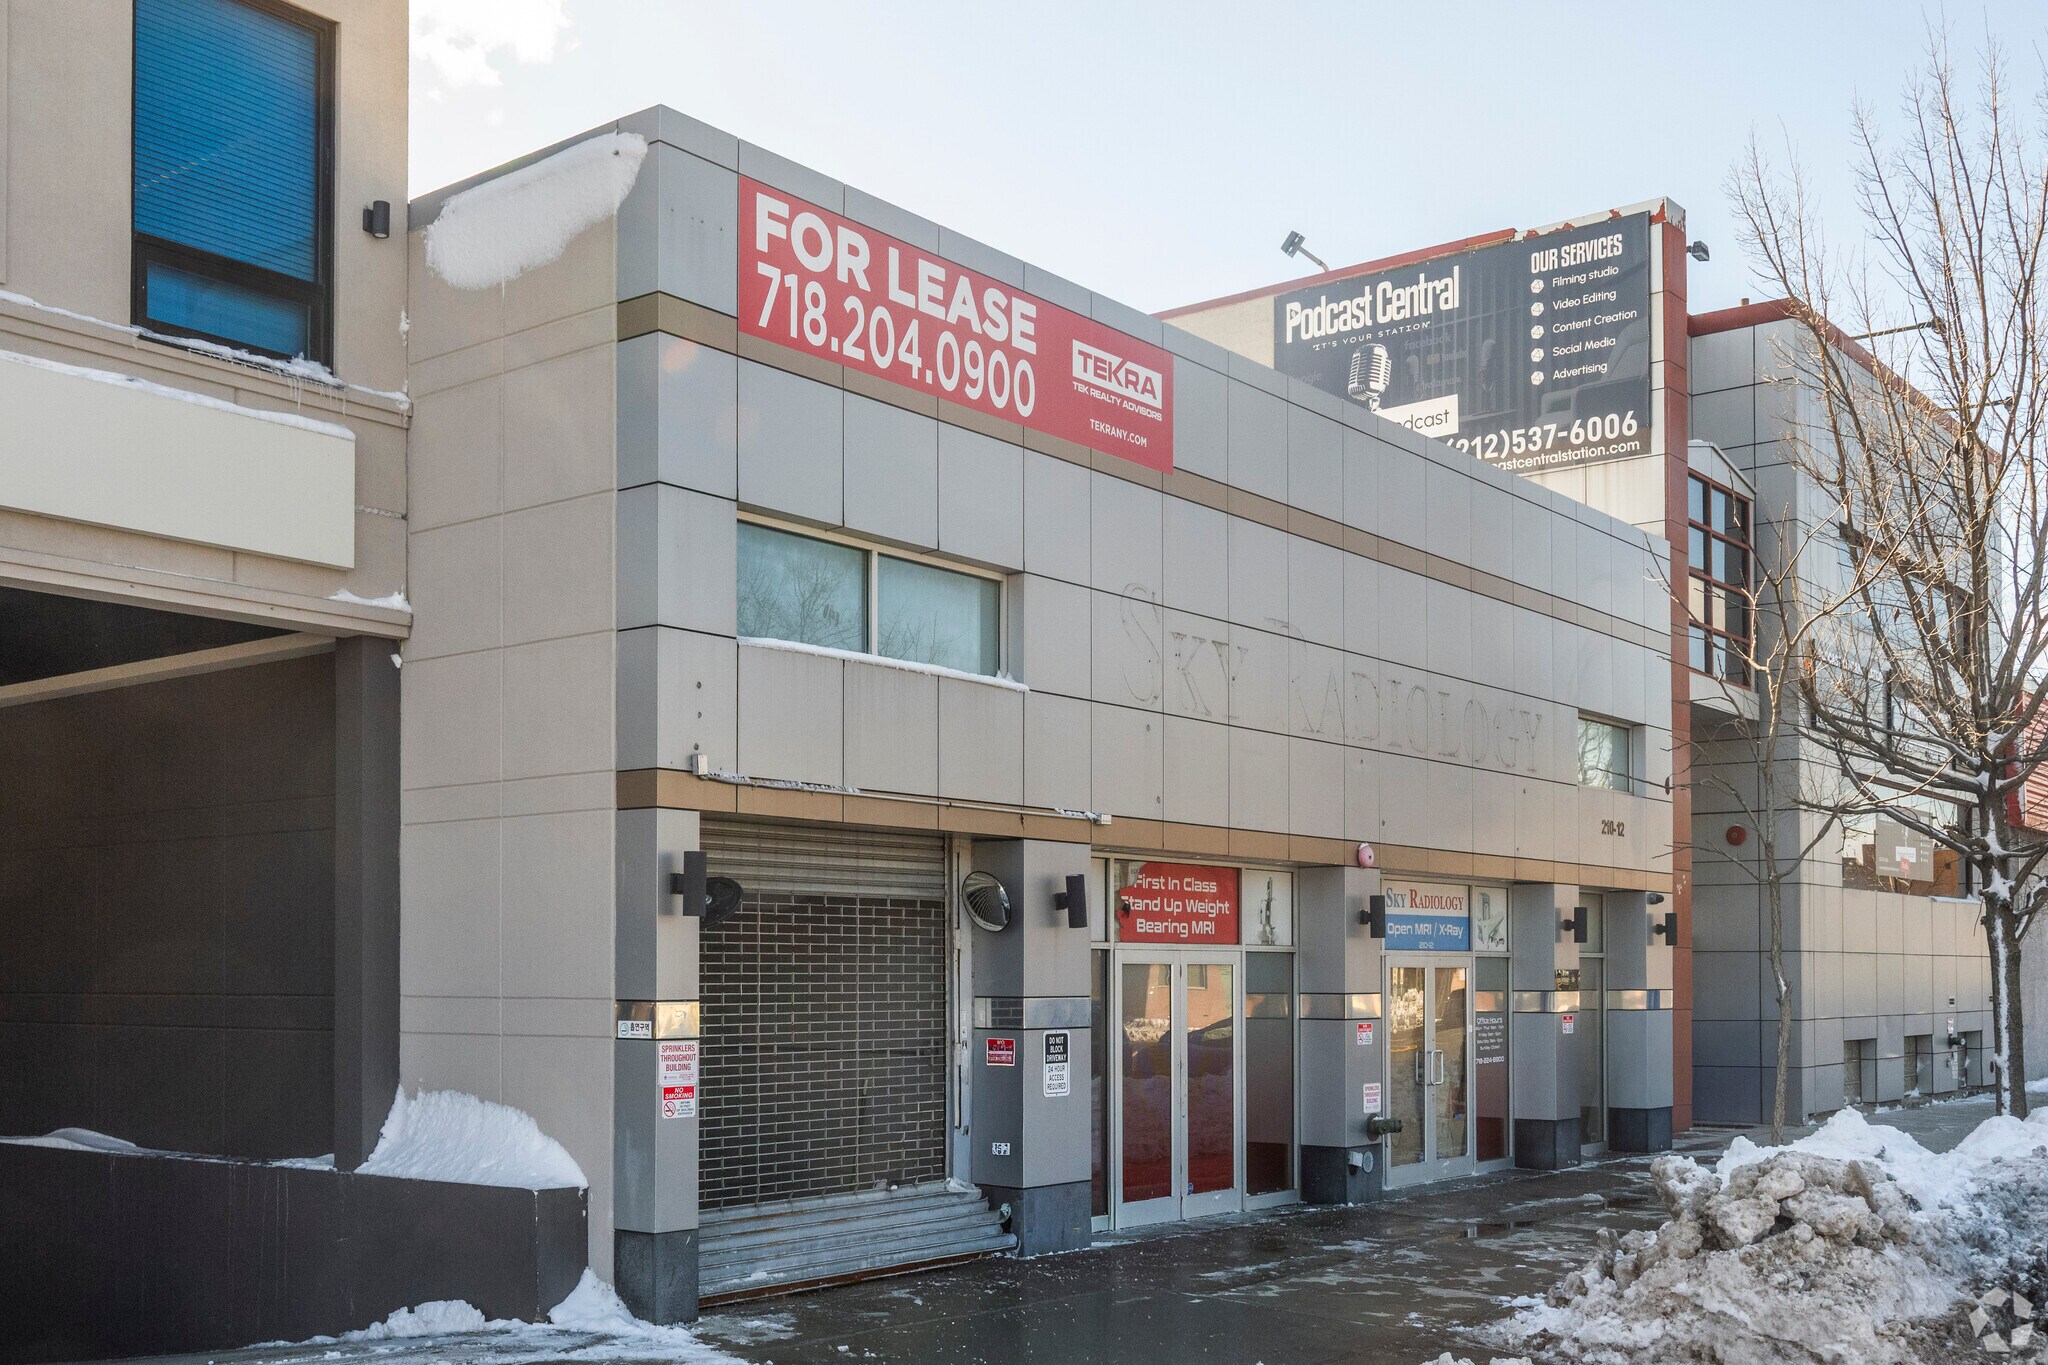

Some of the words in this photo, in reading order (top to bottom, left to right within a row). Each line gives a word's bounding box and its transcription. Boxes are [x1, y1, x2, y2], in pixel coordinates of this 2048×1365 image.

[1531, 248, 1558, 274] OUR
[1561, 233, 1623, 268] SERVICES
[756, 192, 871, 291] FOR
[888, 246, 1037, 355] LEASE
[1552, 272, 1587, 288] Filming
[1588, 265, 1619, 280] studio
[1286, 285, 1373, 344] Podcast
[1376, 265, 1460, 323] Central
[1552, 297, 1581, 310] Video
[1583, 290, 1617, 305] Editing
[1552, 318, 1592, 334] Content
[1594, 309, 1637, 326] Creation
[757, 261, 1036, 418] 718.204.0900
[1343, 333, 1372, 345] YOUR
[1404, 332, 1452, 350] facebook
[1552, 342, 1582, 357] Social
[1584, 337, 1616, 351] Media
[1078, 349, 1157, 400] TEKRA
[1552, 362, 1608, 380] Advertising
[1073, 381, 1089, 394] TEK
[1090, 388, 1121, 406] REALTY
[1122, 400, 1162, 422] ADVISORS
[1398, 409, 1450, 430] dcast
[1090, 418, 1147, 447] TEKRANY.COM
[1491, 440, 1640, 470] astcentralstation.com
[1601, 819, 1625, 837] 210-12
[1134, 874, 1165, 890] First
[1168, 877, 1180, 891] In
[1183, 877, 1217, 893] Class
[1164, 898, 1183, 916] Up
[1185, 899, 1230, 918] Weight
[1386, 887, 1406, 908] SKY
[1409, 889, 1464, 910] RADIOLOGY
[1136, 918, 1189, 938] Bearing
[1192, 920, 1215, 935] MRI
[1387, 923, 1413, 938] Open
[1415, 923, 1432, 935] MRI
[1439, 923, 1464, 939] X-Ray
[630, 1022, 650, 1032] 흡연구역
[661, 1044, 696, 1053] SPRINKLERS
[1049, 1036, 1055, 1044] DO
[1056, 1036, 1064, 1044] NOT
[1050, 1045, 1064, 1053] BLOCK
[660, 1053, 697, 1062] THROUGHOUT
[666, 1063, 692, 1072] BUILDING
[1046, 1054, 1067, 1062] DRIVEWAY
[664, 1092, 693, 1100] SMOKING
[1047, 1082, 1066, 1090] REQUIRED
